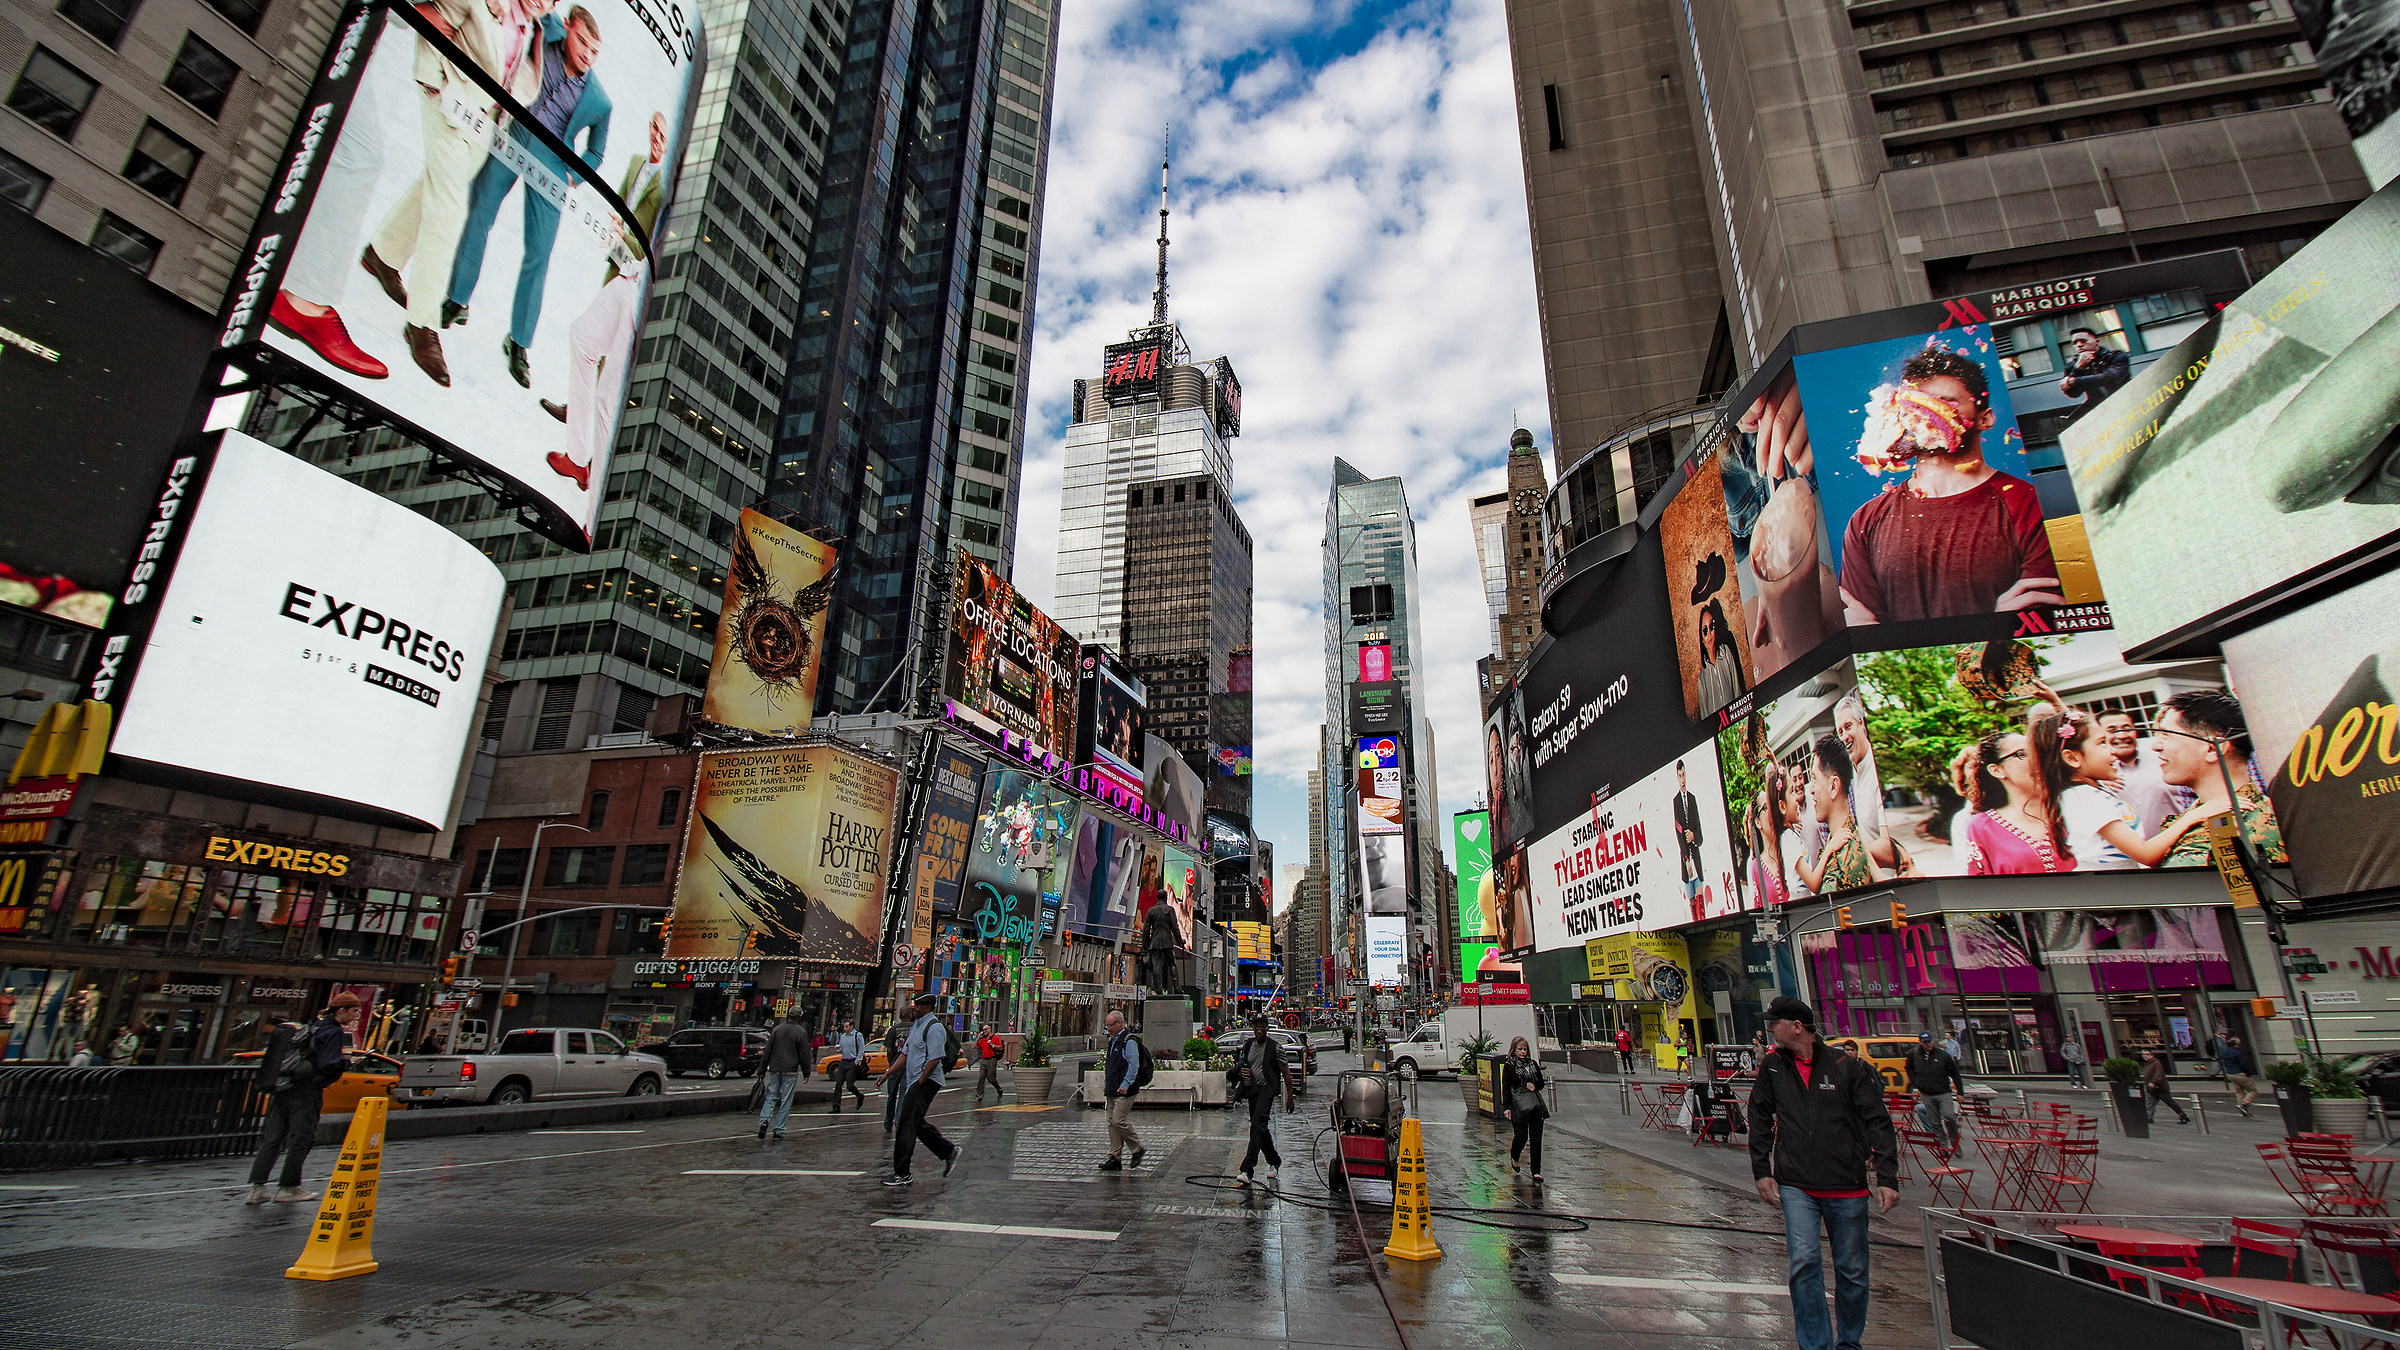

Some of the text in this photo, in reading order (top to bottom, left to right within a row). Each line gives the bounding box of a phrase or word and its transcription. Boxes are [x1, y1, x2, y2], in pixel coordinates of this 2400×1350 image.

[274, 102, 344, 214] EXPRESS
[454, 99, 577, 214] THE WORKWEAR
[1992, 275, 2097, 304] MARRIOTT
[1994, 291, 2091, 317] MARQUIS
[2187, 356, 2210, 383] ON
[2211, 315, 2267, 362] THESE
[2268, 271, 2329, 323] GIRLS!
[1107, 348, 1159, 386] H&M
[1696, 412, 1730, 457] MARRIOTT
[1697, 429, 1729, 469] MARQUIS
[123, 456, 197, 606] EXPRESS
[751, 525, 826, 567] #KeepTheSecrets
[279, 582, 466, 683] EXPRESS
[1364, 632, 1385, 641] 2018
[964, 598, 1072, 690] OFFICE LOCATIONS
[1083, 671, 1094, 679] LG
[369, 668, 440, 705] MADISON
[1360, 689, 1392, 698] LANDMARK
[1366, 696, 1385, 704] SIGNS
[1728, 691, 1755, 715] MARRIOTT
[992, 694, 1041, 733] VORNADO
[1532, 683, 1571, 738] Galaxy S9
[1730, 702, 1754, 722] MARQUIS
[1534, 674, 1628, 769] with Super Slow-mo
[715, 752, 808, 769] "BROADWAY WILL
[1369, 747, 1395, 756] TDK
[706, 762, 815, 780] NEVER BE THE SAME.
[839, 757, 861, 772] WILDLY
[862, 765, 894, 784] THEATRICAL
[841, 768, 884, 789] AND THRILLING
[708, 784, 806, 797] REDEFINES THE POSSIBILITIES
[717, 778, 758, 788] THEATRICAL
[760, 776, 786, 786] MARVEL
[788, 775, 808, 784] THAT
[829, 772, 892, 801] BROADWAY SPECTACLE
[937, 767, 977, 796] BEST MUSICAL
[1080, 768, 1188, 842] BROADWAY
[827, 811, 884, 852] HARRY
[928, 812, 970, 843] COME
[1572, 810, 1614, 847] STARRING
[205, 836, 351, 877] EXPRESS
[818, 837, 882, 877] POTTER
[1553, 820, 1648, 887] TYLER GLENN
[824, 873, 875, 893] CURSED CHILD
[920, 886, 930, 896] THE
[1562, 861, 1641, 909] LEAD SINGER OF
[917, 896, 930, 910] LION
[914, 911, 930, 929] KING
[1566, 892, 1644, 938] NEON TREES
[1607, 949, 1629, 962] INVICTA
[633, 962, 677, 974] GIFTS
[160, 983, 223, 996] EXPRESS
[252, 987, 309, 999] EXPRESS
[362, 1152, 380, 1160] CAUTION
[330, 1181, 350, 1190] SAFETY
[354, 1179, 377, 1190] SAFETY
[355, 1189, 373, 1199] FIRST
[1397, 1181, 1413, 1190] SAFETY
[1399, 1189, 1411, 1197] FIRST
[1415, 1182, 1427, 1190] SAFETY
[1417, 1189, 1426, 1197] FIRST
[329, 1191, 345, 1199] FIRST
[329, 1203, 337, 1211] LA
[347, 1209, 373, 1220] SEGURIDAD
[357, 1202, 366, 1211] LA
